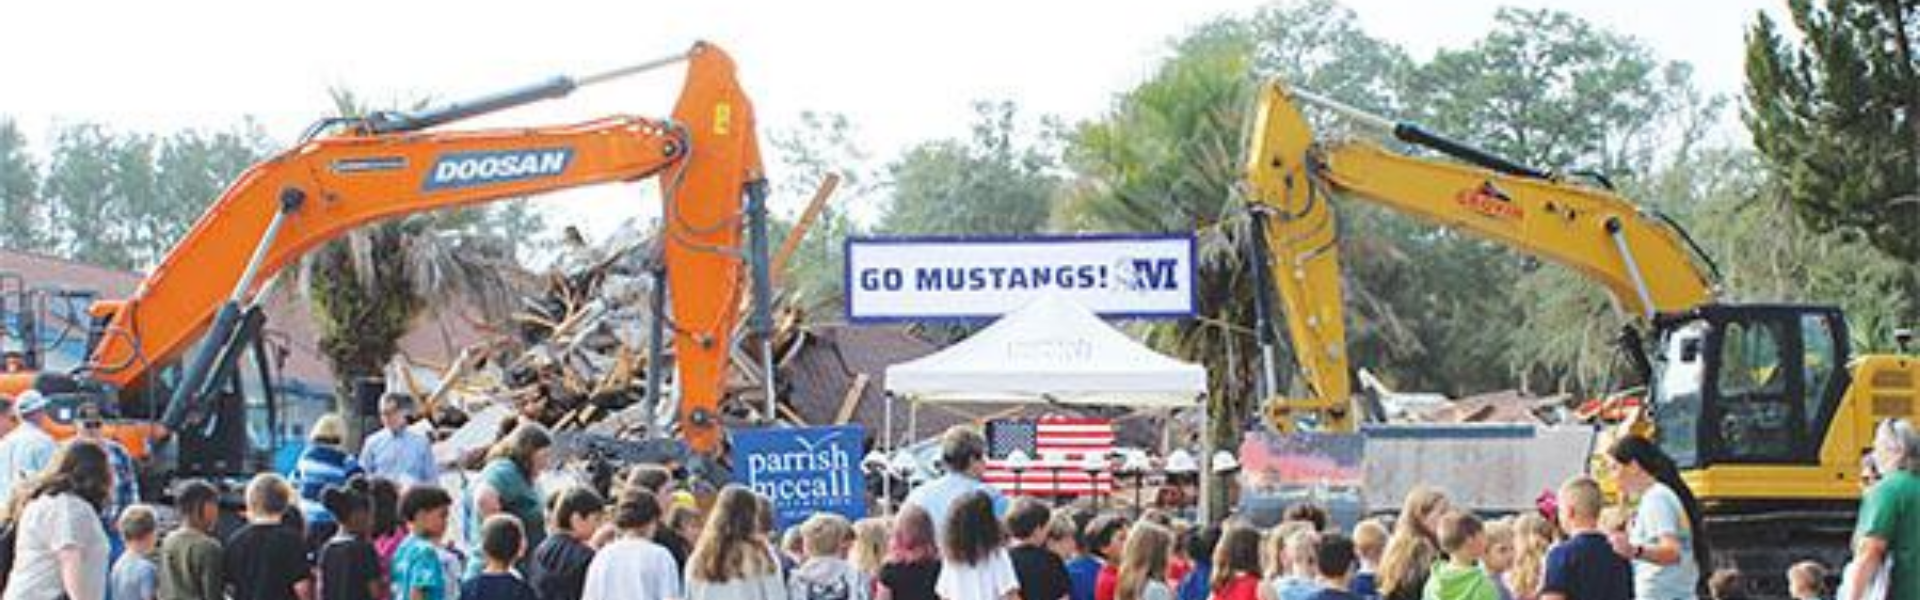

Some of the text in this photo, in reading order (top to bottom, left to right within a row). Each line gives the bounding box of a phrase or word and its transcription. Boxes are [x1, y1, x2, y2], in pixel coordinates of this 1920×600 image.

[434, 151, 565, 183] DOOSAN
[861, 267, 903, 291] GO
[916, 265, 1107, 291] MUSTANGS!
[748, 442, 850, 481] parrish
